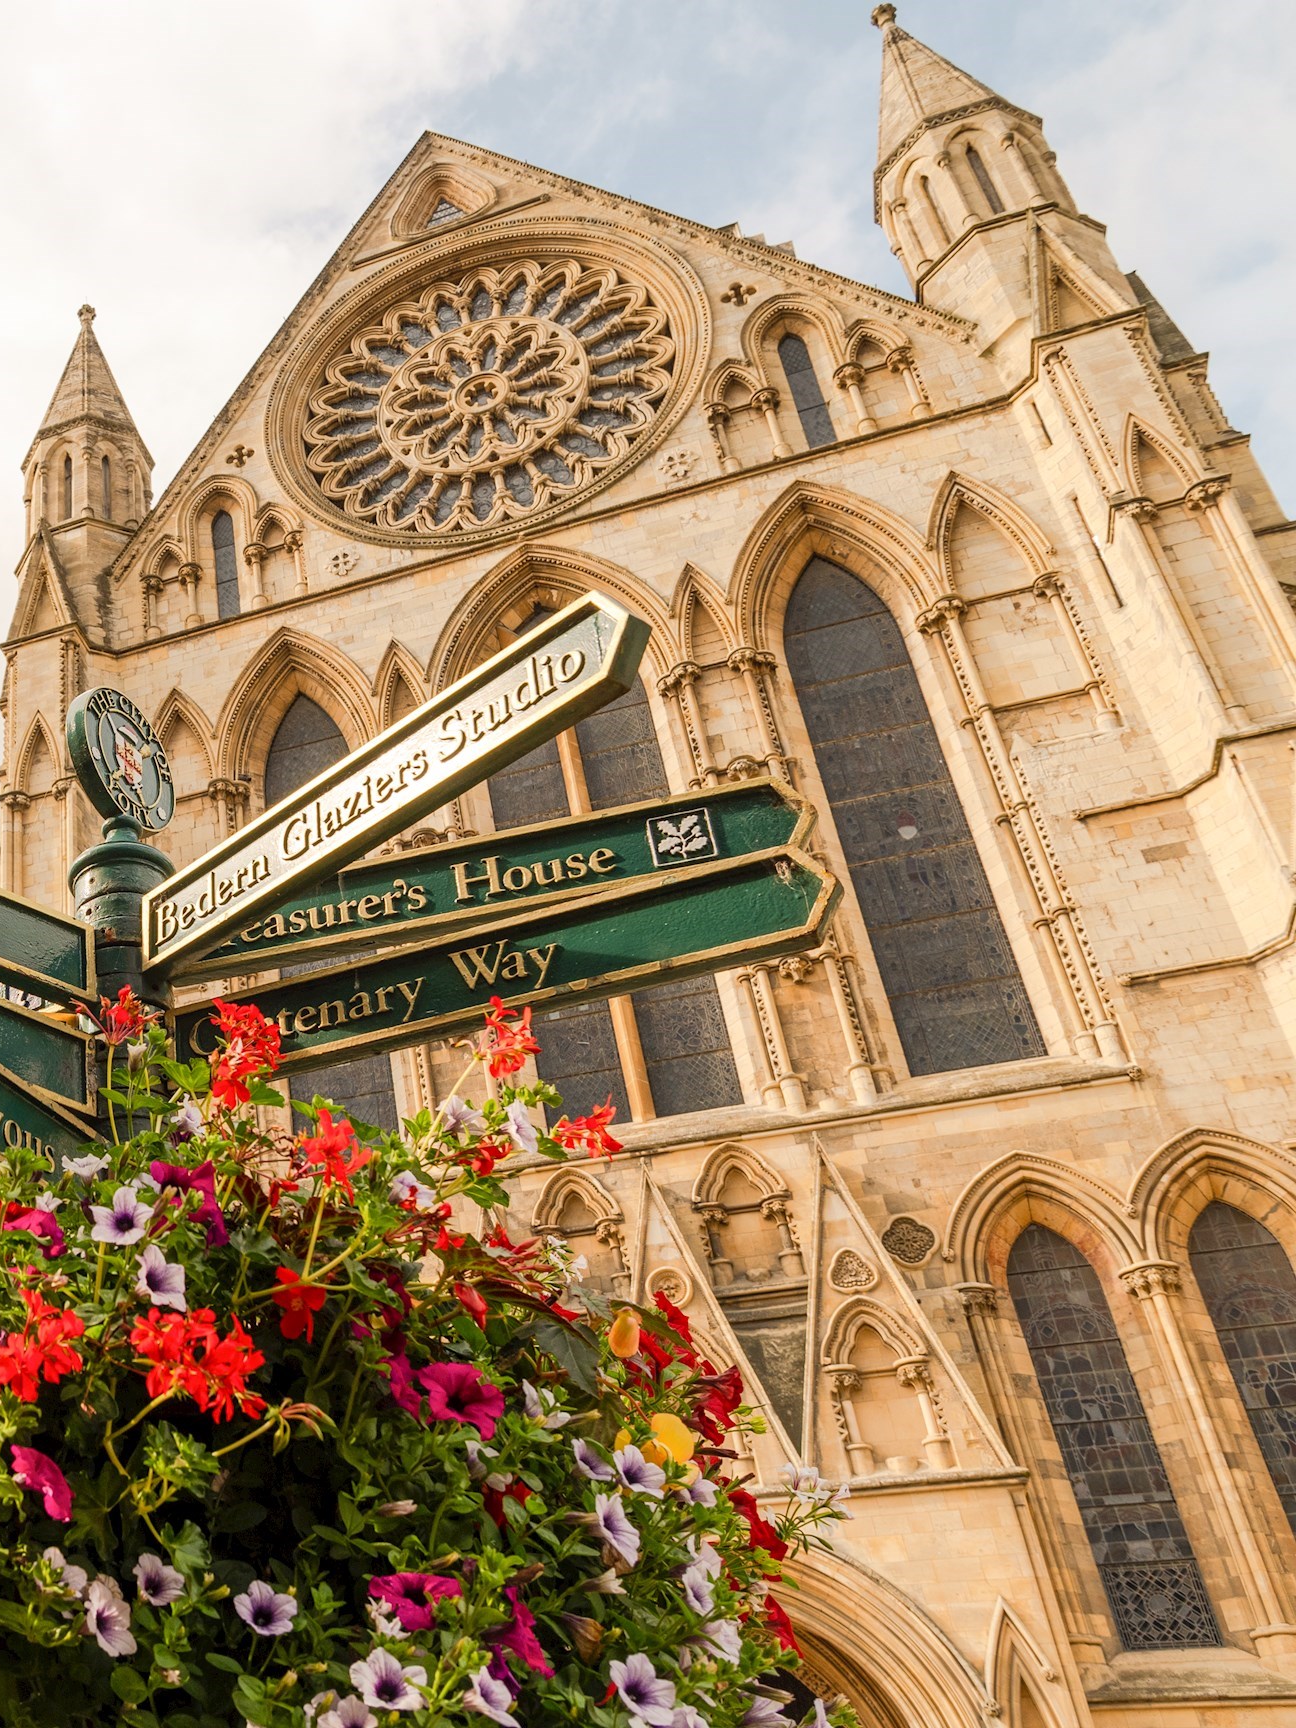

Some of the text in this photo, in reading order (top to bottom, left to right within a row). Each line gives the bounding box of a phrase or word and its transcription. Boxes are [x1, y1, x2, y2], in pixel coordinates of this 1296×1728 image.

[88, 689, 172, 828] THE CITY OF YORK
[155, 649, 585, 947] Bedern Glaziers Studio
[220, 847, 616, 947] easurer's House
[189, 938, 558, 1055] Ctenary Way
